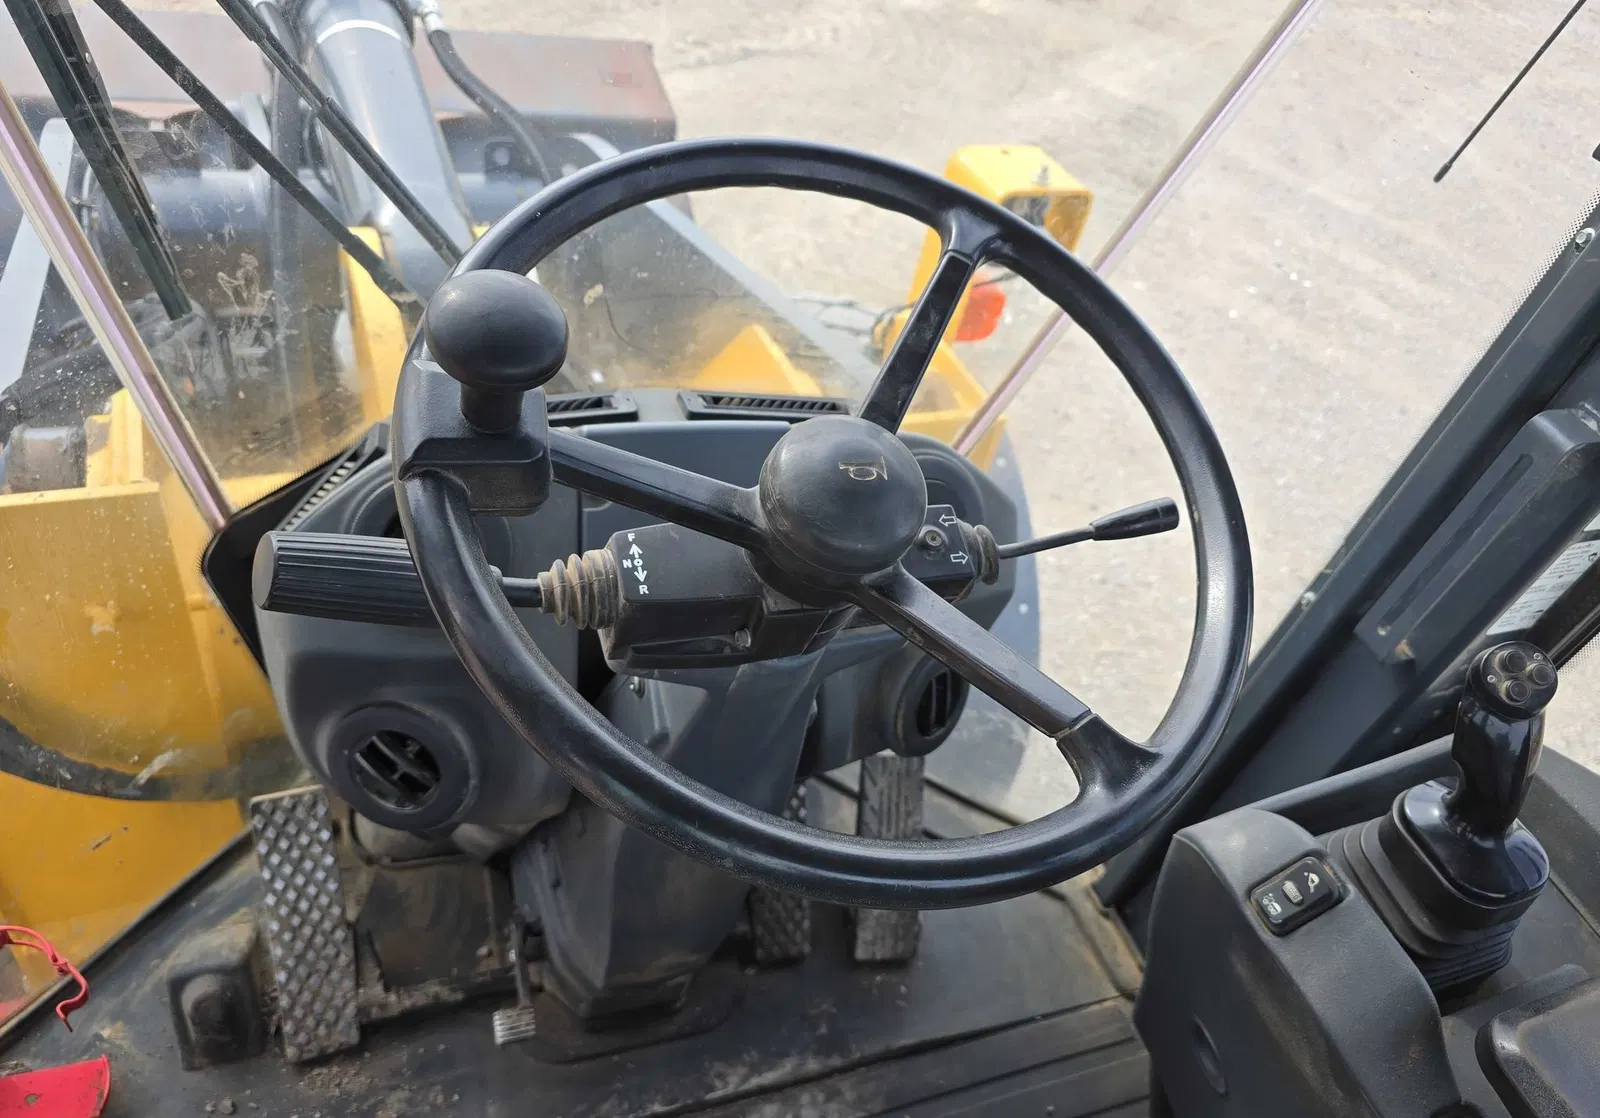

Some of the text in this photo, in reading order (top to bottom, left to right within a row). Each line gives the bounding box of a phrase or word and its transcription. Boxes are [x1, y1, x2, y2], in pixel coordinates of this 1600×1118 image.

[627, 533, 636, 542] F
[622, 559, 633, 568] N
[638, 584, 649, 595] R
